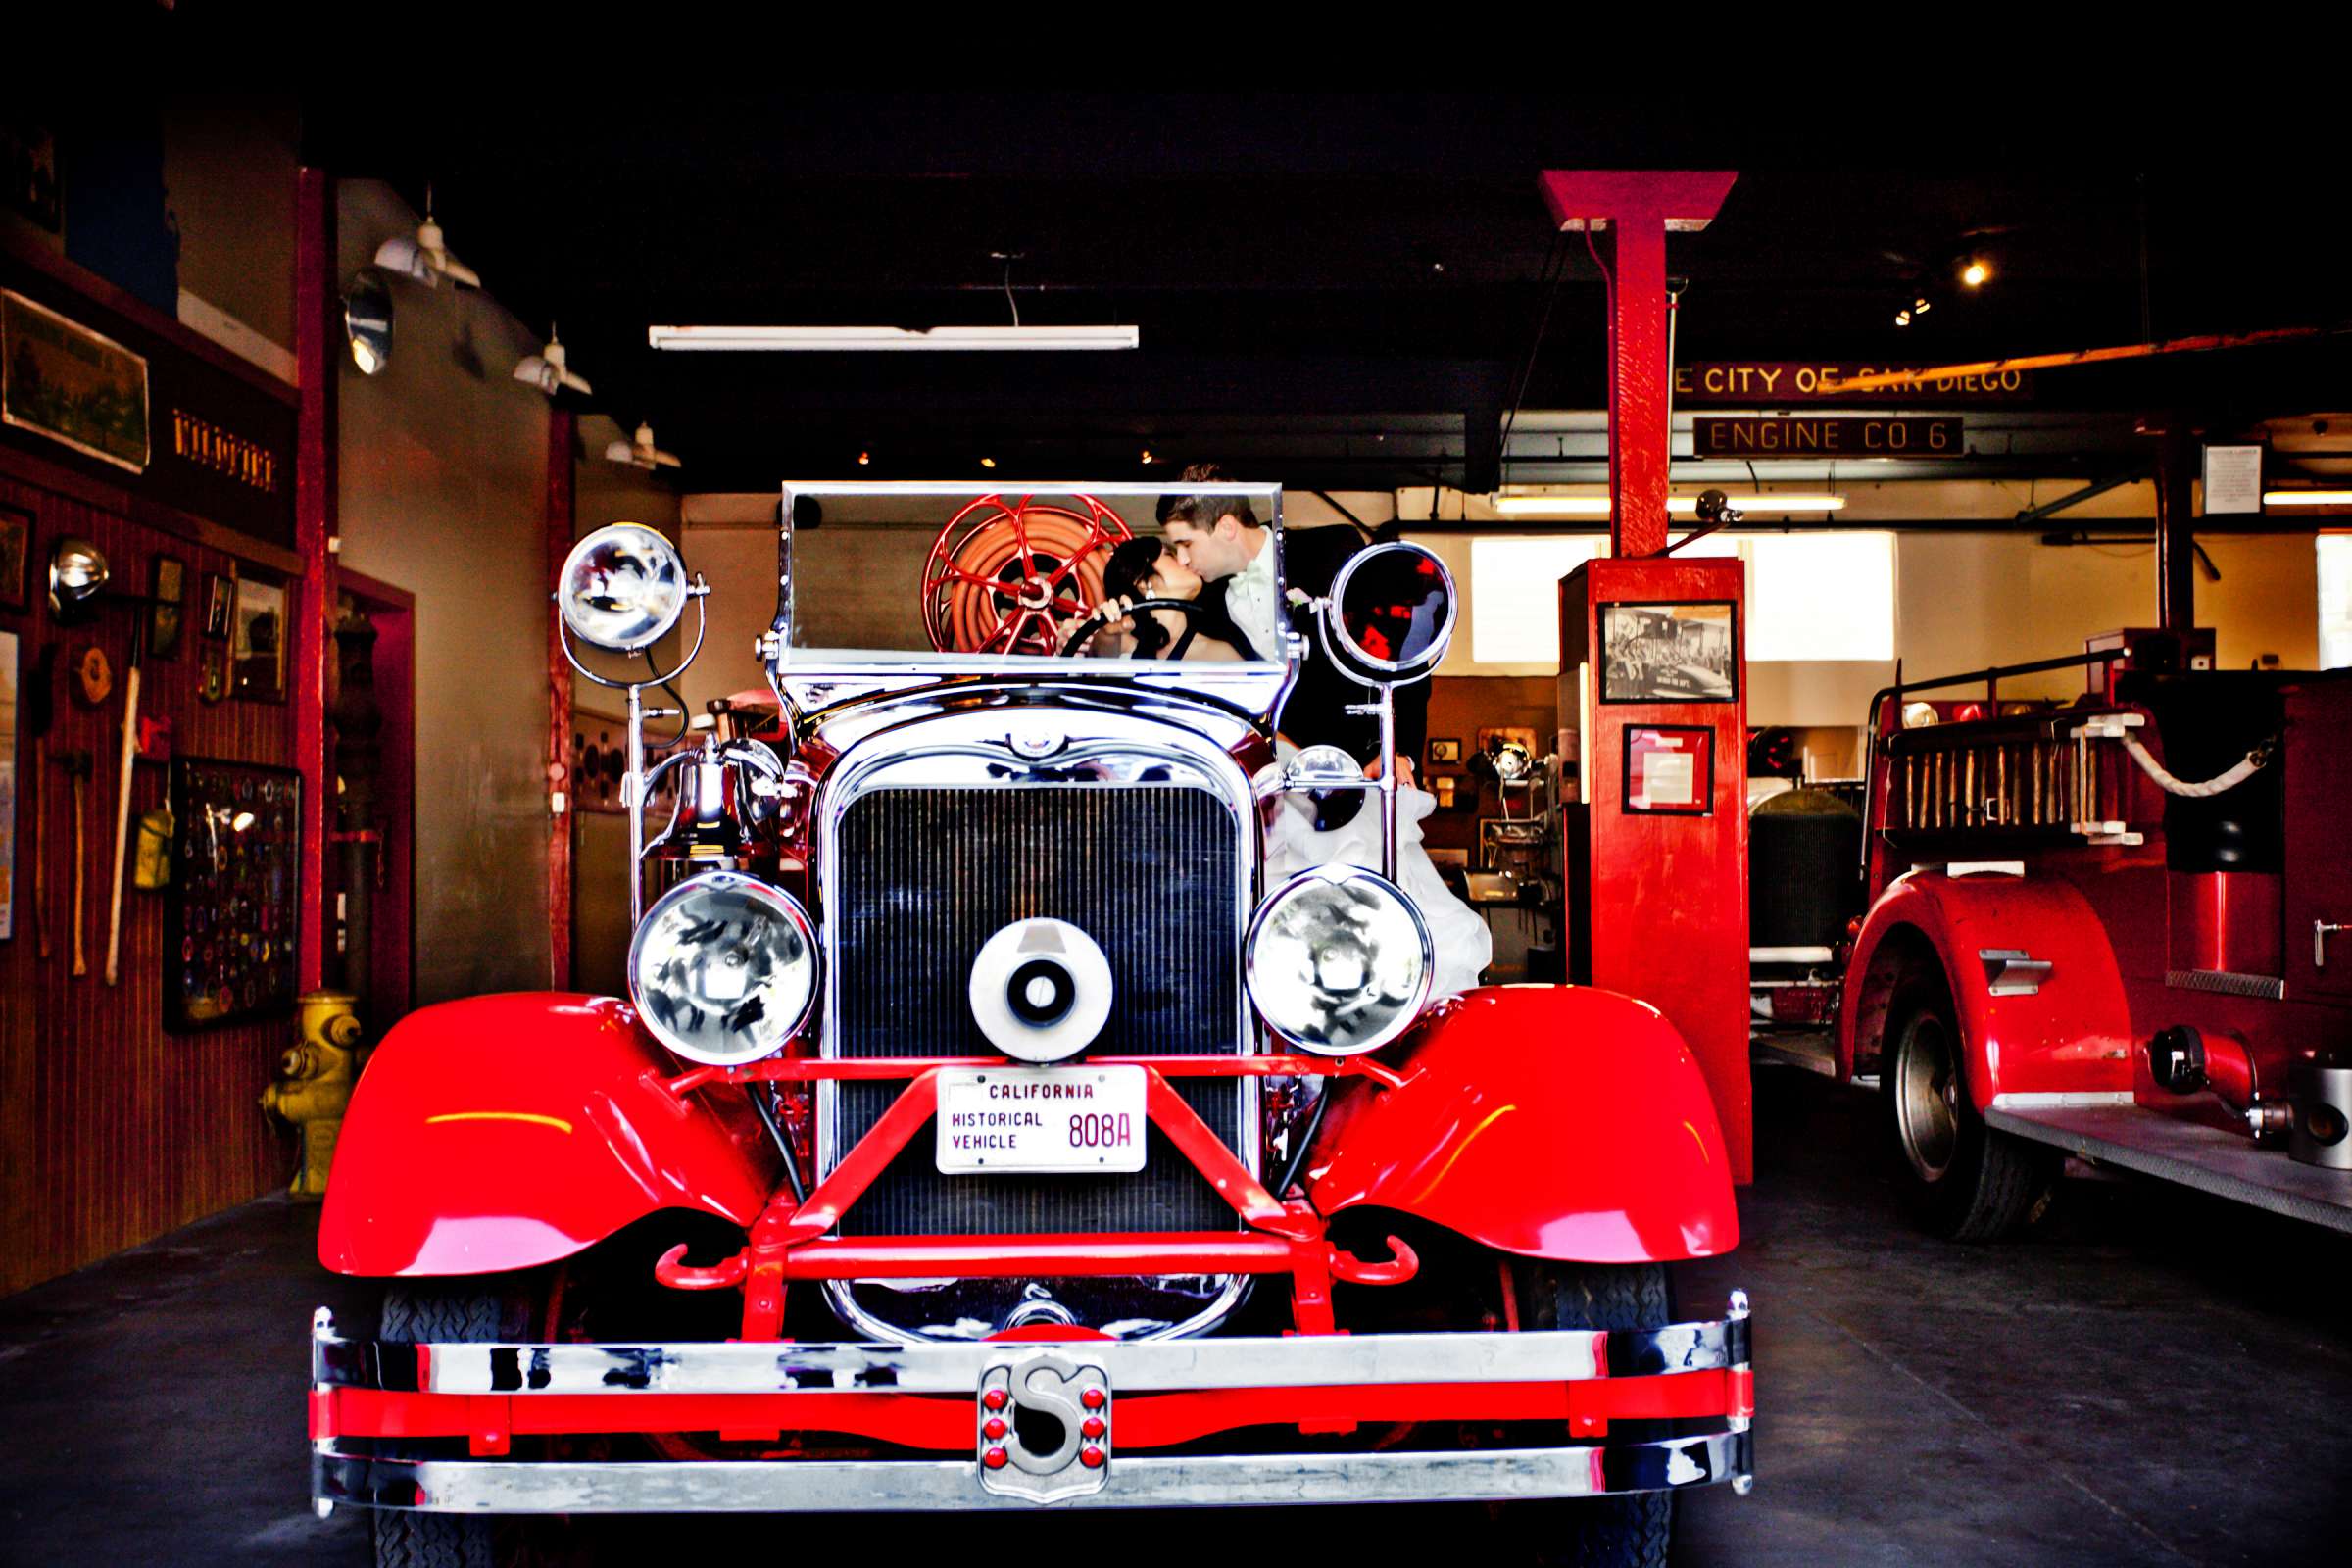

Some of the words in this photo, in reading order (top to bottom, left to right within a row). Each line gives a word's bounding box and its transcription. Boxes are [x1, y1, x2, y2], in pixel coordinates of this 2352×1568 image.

[1704, 368, 1783, 393] CITY
[1795, 368, 1840, 393] OF
[1936, 368, 2022, 393] DIEGO
[1710, 421, 1840, 450] ENGINE
[1864, 421, 1907, 450] CO
[1929, 421, 1947, 450] 6
[989, 1083, 1094, 1100] CALIFORNIA
[952, 1112, 1043, 1127] HISTORICAL
[1068, 1112, 1131, 1148] 808A
[952, 1134, 1018, 1150] VEHICLE
[1004, 1354, 1083, 1476] S
